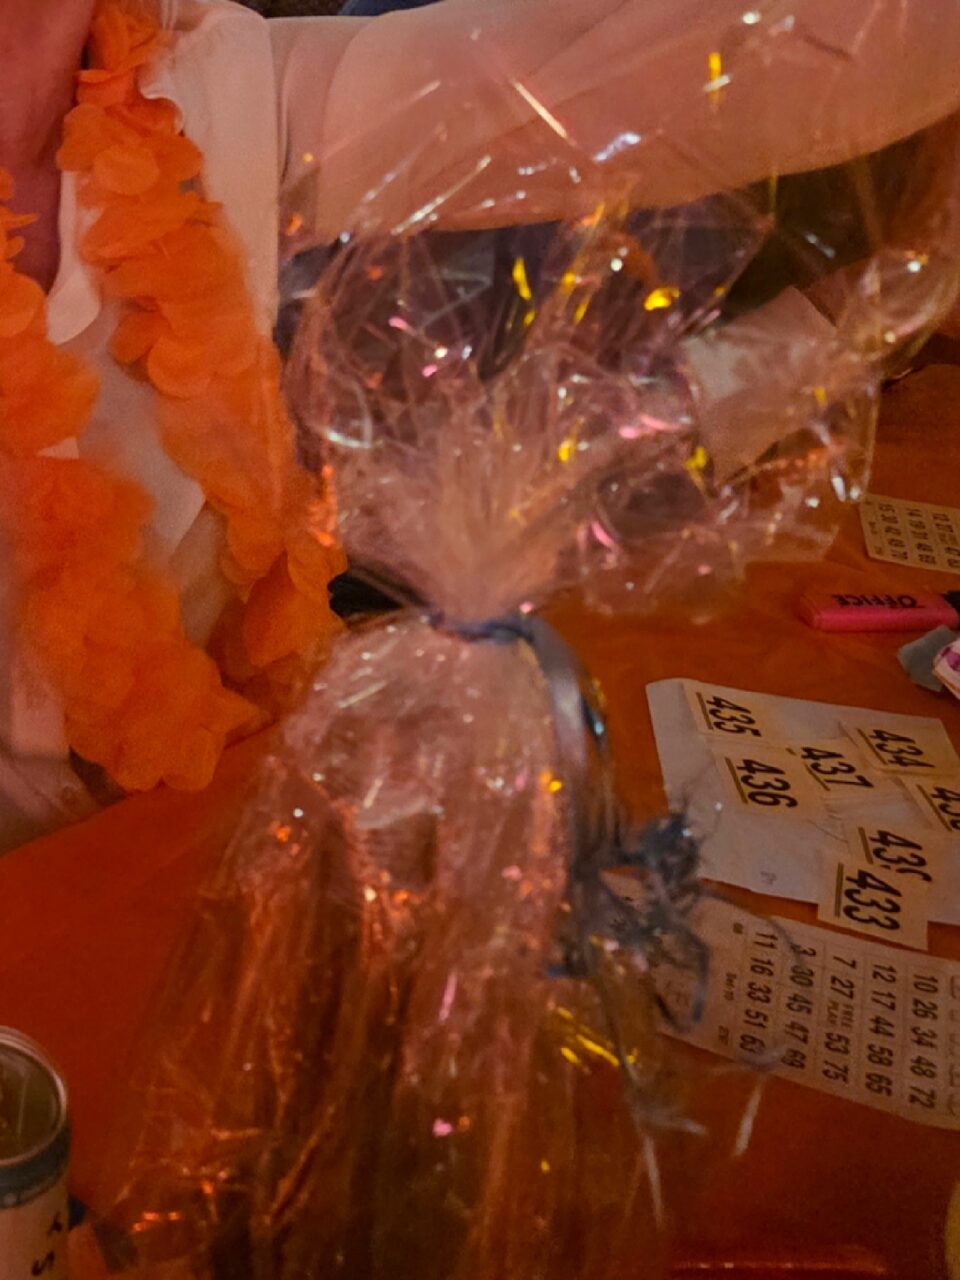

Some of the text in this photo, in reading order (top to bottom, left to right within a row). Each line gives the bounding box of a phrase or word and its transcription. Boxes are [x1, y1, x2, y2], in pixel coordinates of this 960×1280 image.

[833, 594, 918, 608] OFFICE
[706, 695, 763, 738] 435
[869, 728, 936, 769] 434
[736, 758, 799, 810] 436
[842, 869, 903, 932] 433
[755, 931, 779, 950] 11
[749, 956, 774, 978] 16
[832, 955, 858, 970] 7
[789, 965, 815, 989] 30
[830, 975, 855, 1000] 27
[747, 981, 772, 1006] 33
[787, 994, 813, 1016] 45
[742, 1007, 769, 1031] 51
[865, 963, 897, 1098] 12 17 44 58 65
[784, 1021, 810, 1045] 47
[823, 1032, 851, 1056] 53
[908, 973, 939, 1110] 10 26 34 48 72
[822, 1059, 849, 1085] 75
